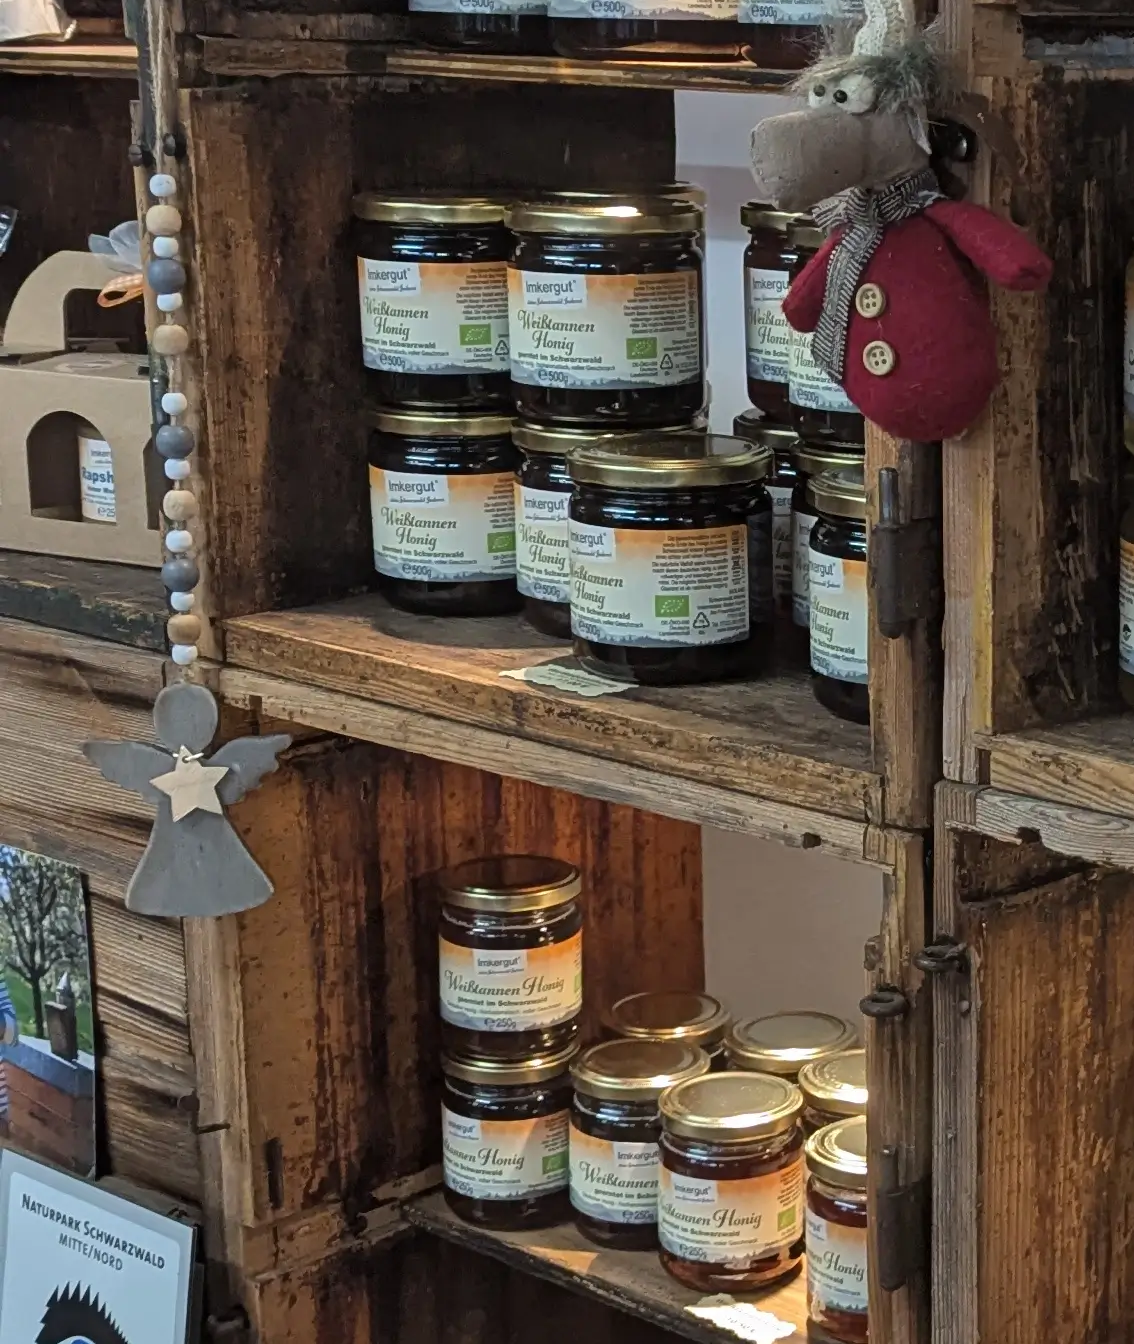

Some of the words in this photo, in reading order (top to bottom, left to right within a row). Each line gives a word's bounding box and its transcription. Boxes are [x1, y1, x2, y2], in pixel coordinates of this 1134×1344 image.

[374, 316, 410, 341] Honig
[532, 330, 574, 356] Honig
[518, 523, 568, 548] Weißtann
[444, 970, 521, 996] Weißtannen
[59, 1233, 123, 1271] MITTE/NORD
